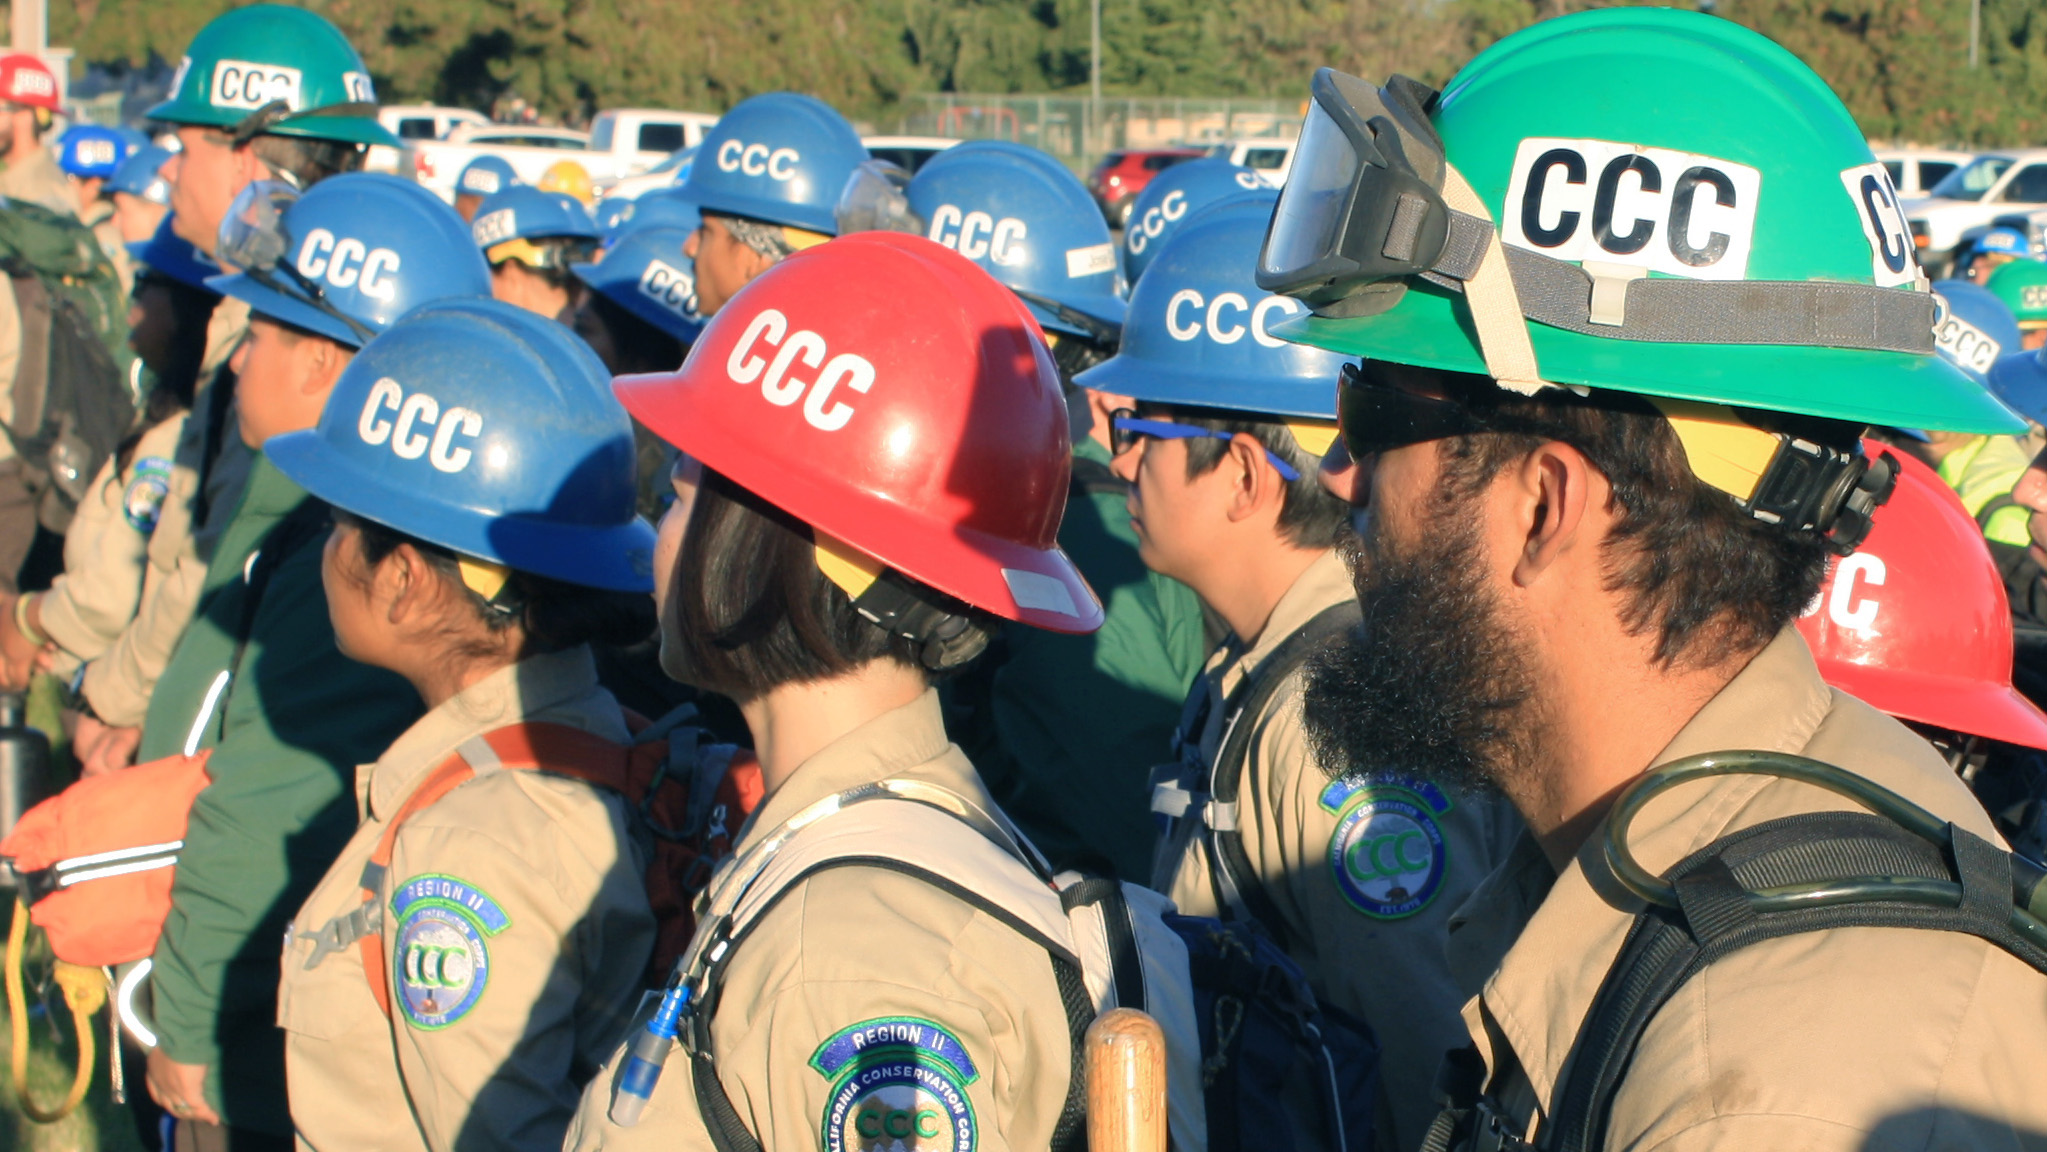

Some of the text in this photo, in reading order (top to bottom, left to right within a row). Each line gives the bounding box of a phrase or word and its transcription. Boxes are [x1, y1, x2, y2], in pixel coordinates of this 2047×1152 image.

[717, 138, 799, 181] CCC
[928, 203, 1027, 266] CCC
[1127, 189, 1188, 255] CCC
[1521, 148, 1736, 267] CCC
[1860, 172, 1918, 274] C
[296, 227, 401, 301] CCC
[1165, 289, 1298, 348] CCC
[1938, 319, 1993, 366] CCC
[726, 308, 876, 432] CCC
[358, 376, 483, 474] CCC
[1347, 830, 1429, 881] CCC
[407, 880, 463, 901] REGION
[404, 944, 467, 988] CCC
[852, 1025, 945, 1050] REGION II
[829, 1065, 970, 1152] ALIFORNIA CONSERVATION COR
[855, 1108, 939, 1139] CCC
